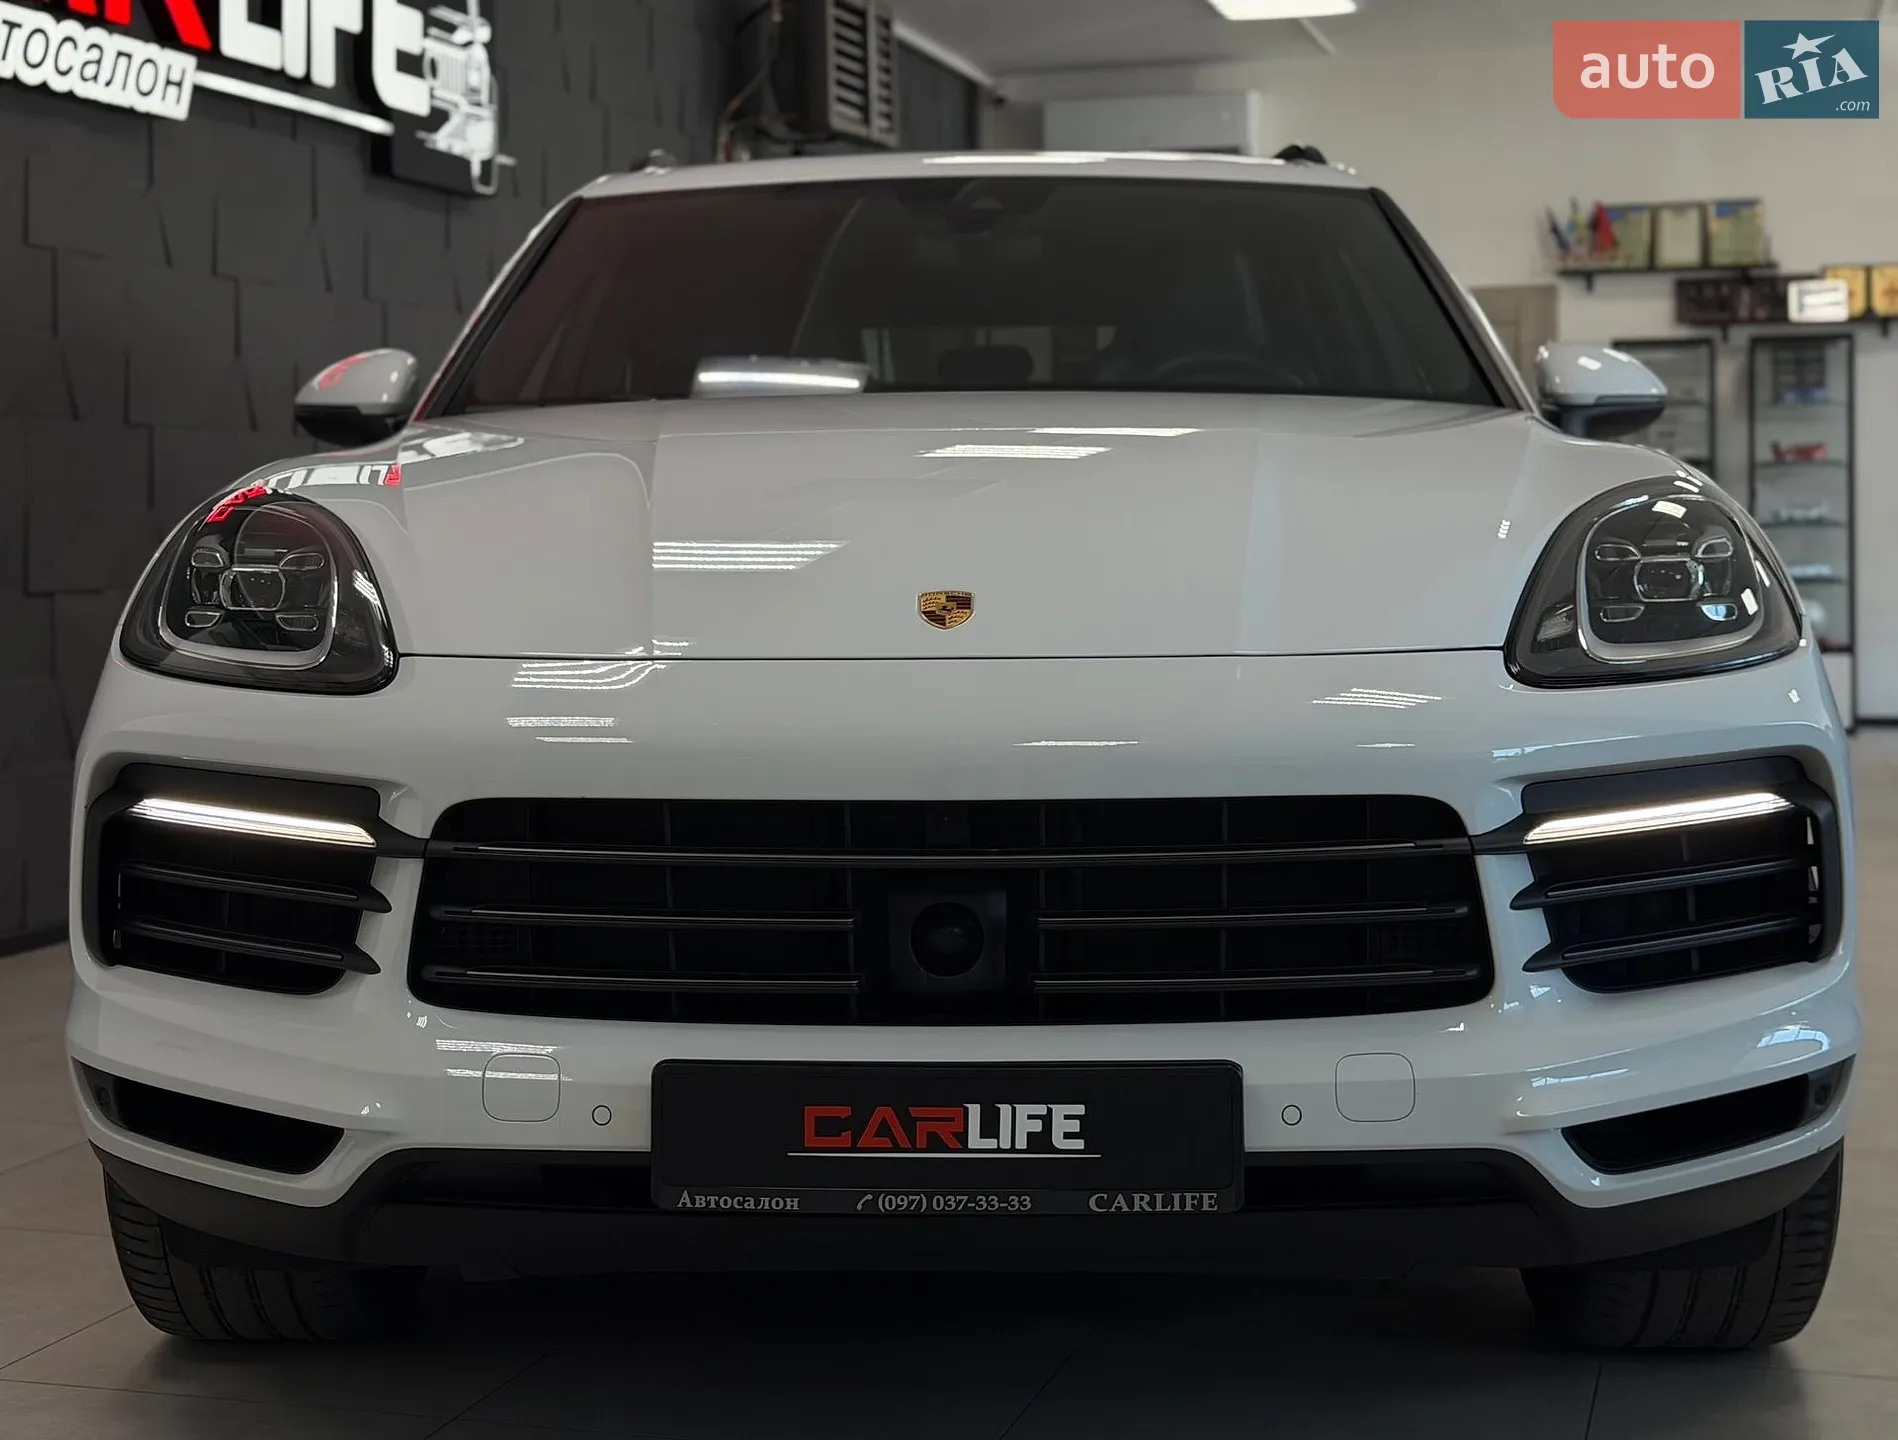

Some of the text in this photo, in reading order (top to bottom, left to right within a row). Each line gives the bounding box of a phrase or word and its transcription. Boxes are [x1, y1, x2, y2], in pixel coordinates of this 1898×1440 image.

[804, 1103, 1086, 1150] CARLIFE
[676, 1190, 1219, 1213] Автосалон (097) 037-33-33 CARLIFE
